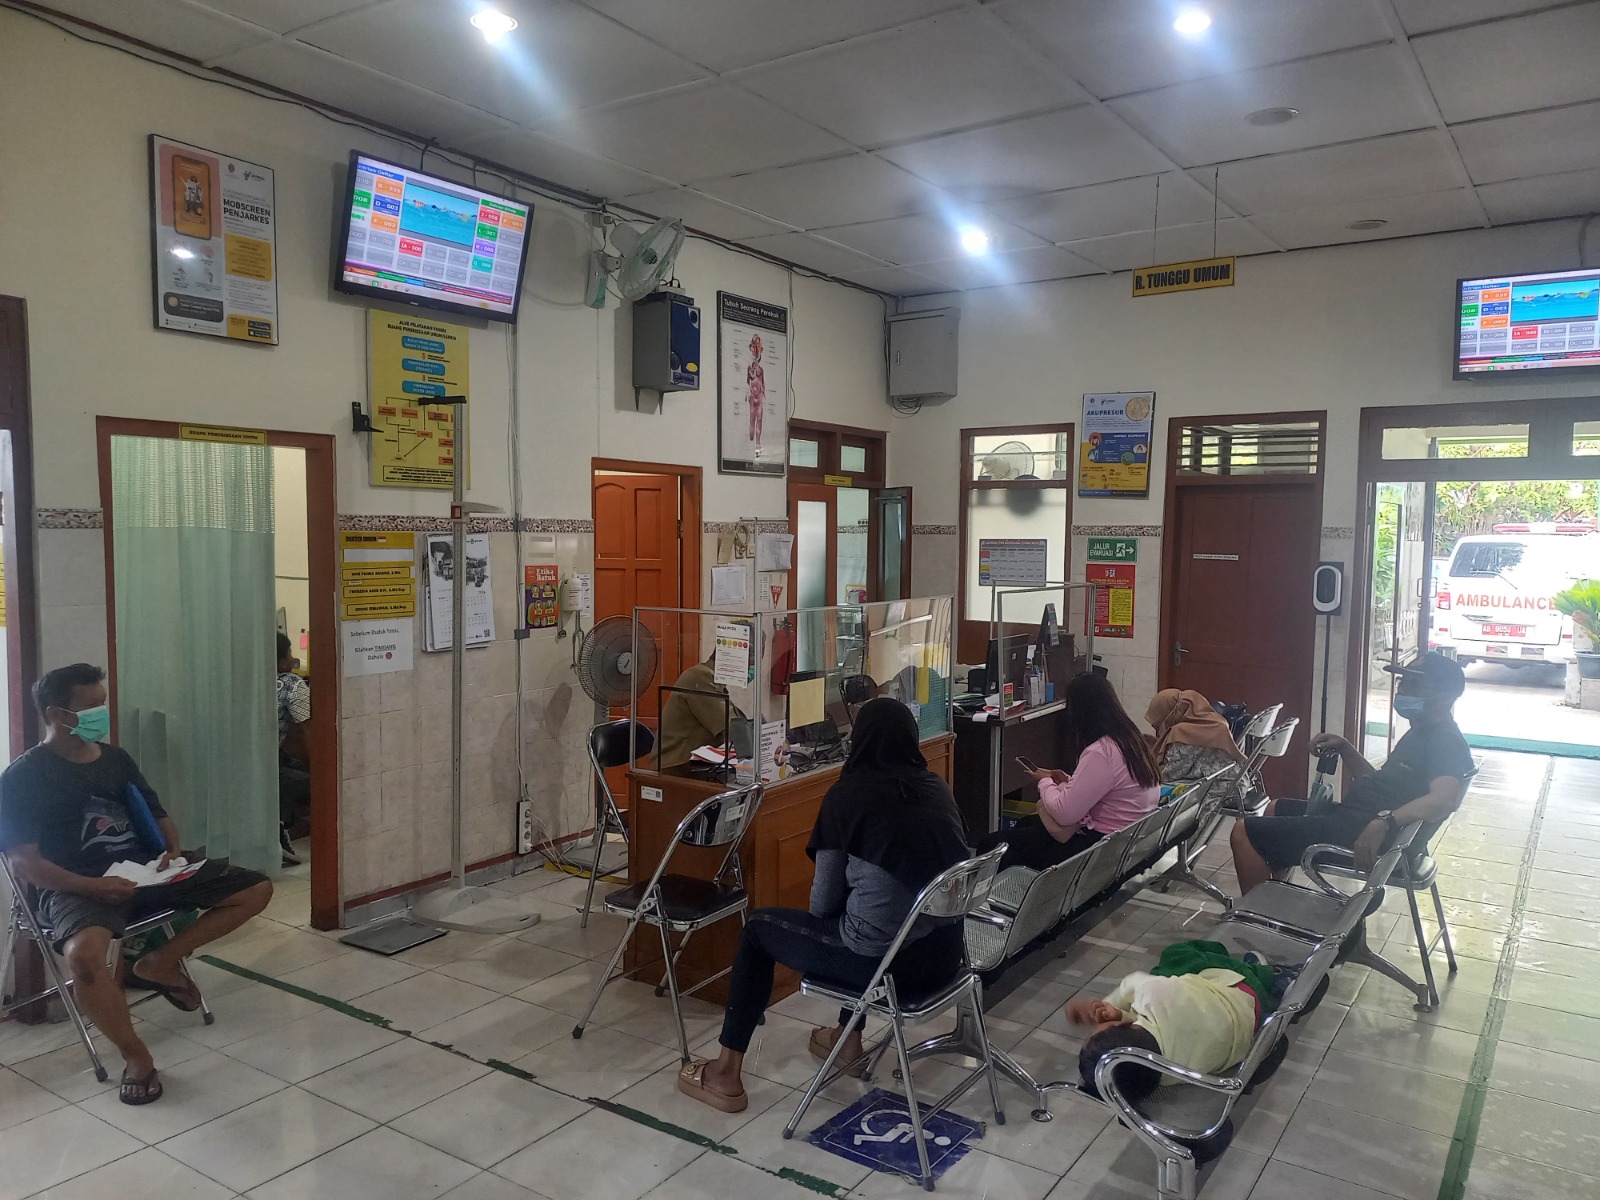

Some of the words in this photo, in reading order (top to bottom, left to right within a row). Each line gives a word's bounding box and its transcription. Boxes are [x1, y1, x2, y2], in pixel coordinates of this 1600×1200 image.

[223, 198, 270, 217] MOBSCREEN
[223, 207, 269, 225] PENJARKES
[1135, 275, 1145, 290] R.
[1147, 269, 1191, 289] TUNGGU
[1193, 264, 1231, 283] UMUM
[724, 299, 739, 308] Tubuh
[740, 303, 760, 315] Seorang
[1089, 549, 1114, 557] EVAKUASI
[1093, 542, 1110, 550] JALUR
[1456, 593, 1557, 611] AMBULANCE
[1517, 626, 1526, 634] UA
